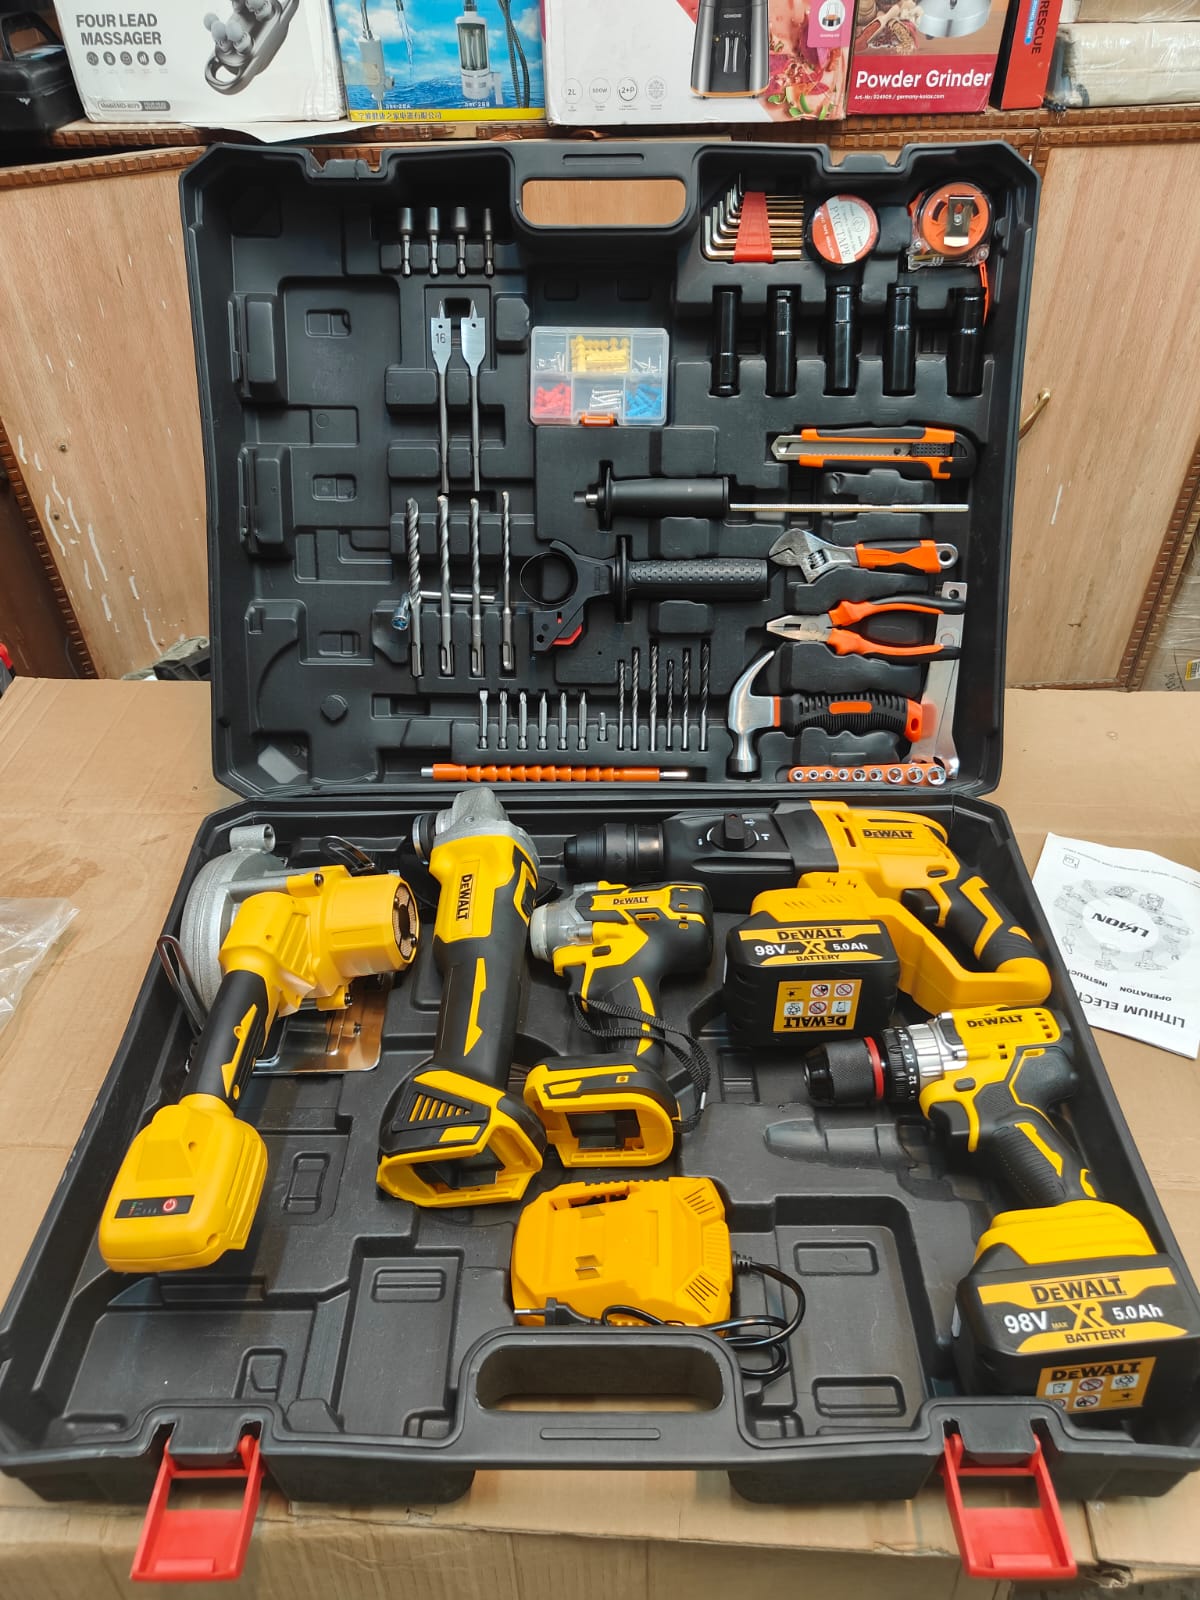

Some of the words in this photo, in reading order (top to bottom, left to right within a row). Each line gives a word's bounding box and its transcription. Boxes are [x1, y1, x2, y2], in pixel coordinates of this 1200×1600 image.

[75, 14, 116, 28] FOUR
[119, 13, 158, 27] LEAD
[1032, 0, 1050, 54] RESCUE
[80, 31, 162, 45] MASSAGER
[856, 70, 922, 88] Powder
[926, 69, 992, 87] Grinder
[567, 88, 577, 96] 2L
[837, 230, 851, 256] TAPE
[436, 333, 446, 344] 16
[863, 829, 914, 839] DEWALT
[456, 873, 473, 921] DEWALT
[613, 896, 649, 905] DEWALT
[777, 928, 844, 941] DEWALT
[754, 944, 786, 956] 98V
[796, 954, 840, 962] BATTERY
[1119, 986, 1172, 1002] OPERATION
[783, 1015, 847, 1028] DEWALT
[967, 1014, 1024, 1028] DEWALT
[1123, 1004, 1186, 1028] LITHIUM
[906, 1054, 914, 1064] 14
[908, 1075, 917, 1085] 12
[1031, 1277, 1126, 1303] DEWALT
[1004, 1310, 1049, 1334] 98V
[1051, 1321, 1068, 1329] MAX
[1065, 1328, 1127, 1344] BATTERY
[1051, 1361, 1141, 1381] DEWALT
